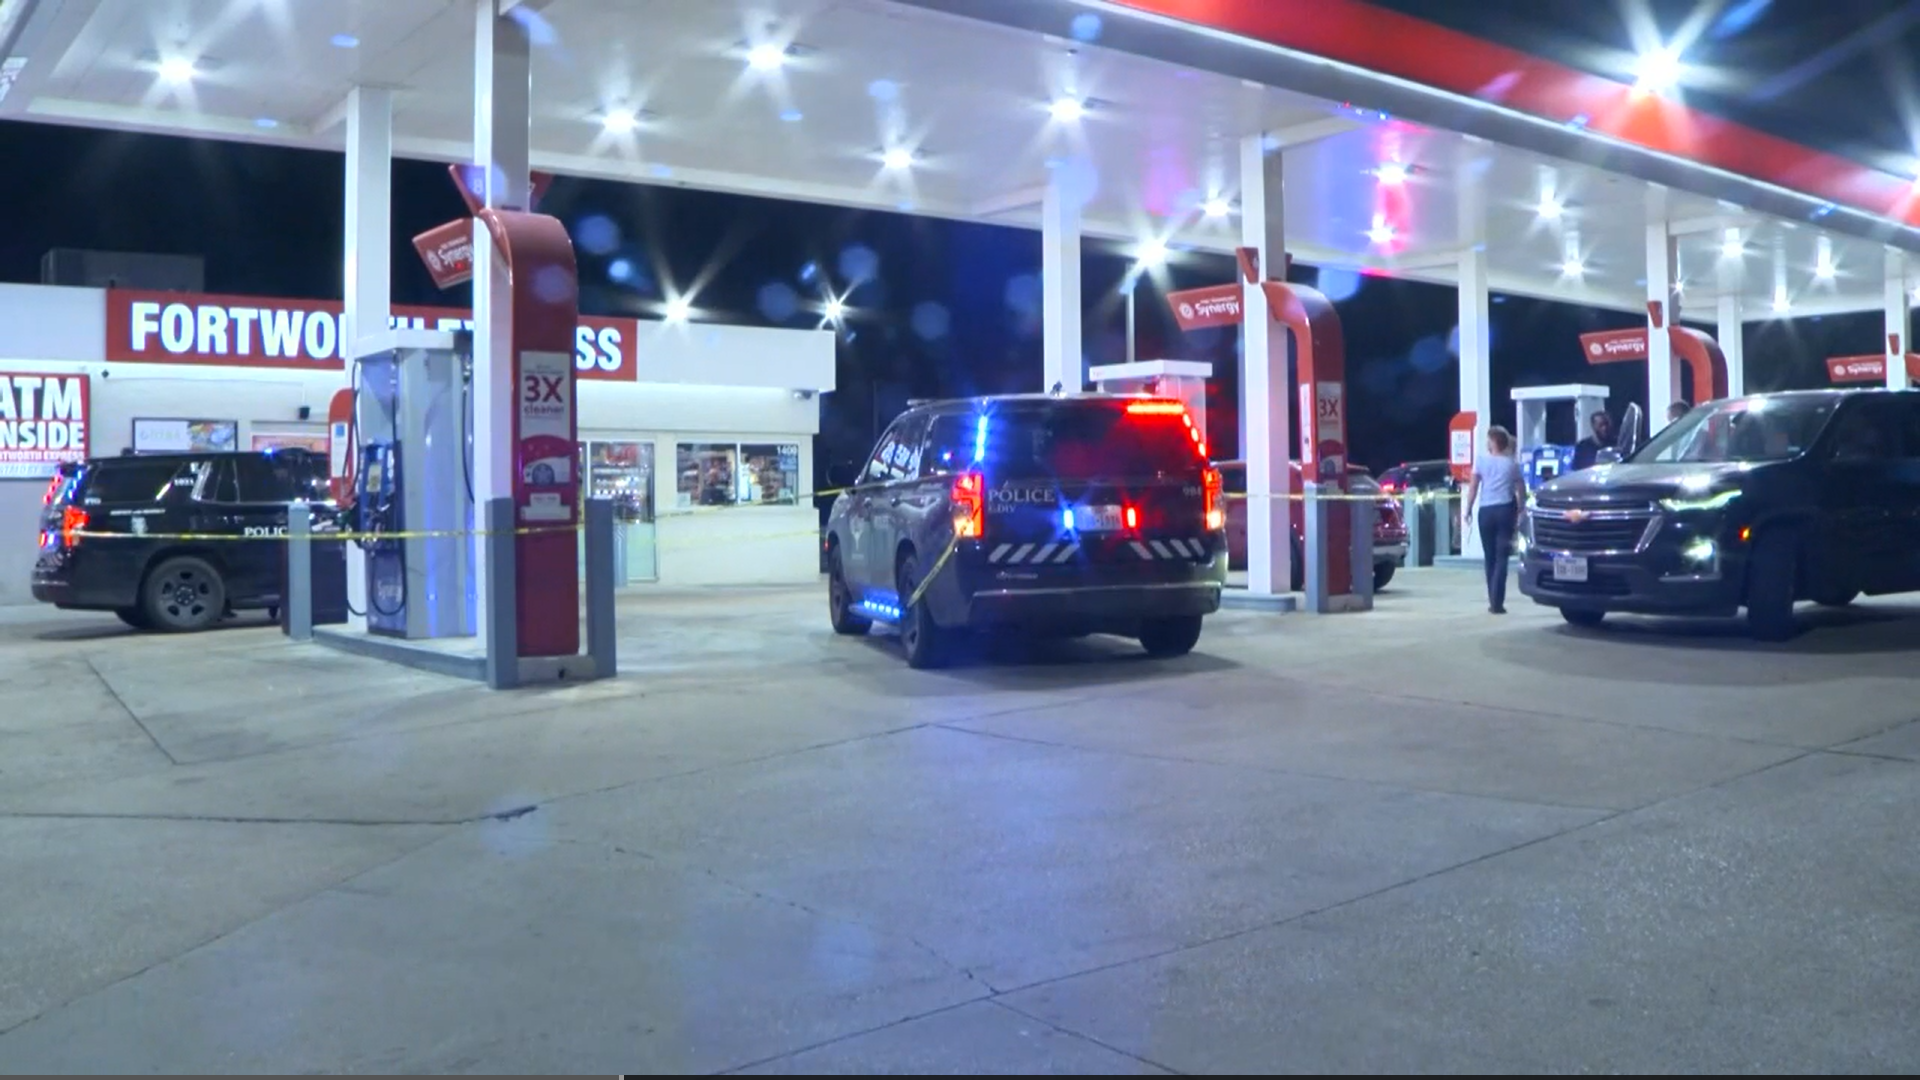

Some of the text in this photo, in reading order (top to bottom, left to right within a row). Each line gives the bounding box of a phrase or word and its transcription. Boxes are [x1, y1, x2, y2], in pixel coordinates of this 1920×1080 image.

[1195, 300, 1240, 318] Synergy
[524, 375, 564, 403] 3X
[1319, 399, 1339, 418] 3X
[0, 420, 85, 449] NSIDE
[988, 489, 1055, 503] POLICE
[244, 526, 288, 538] POLIC
